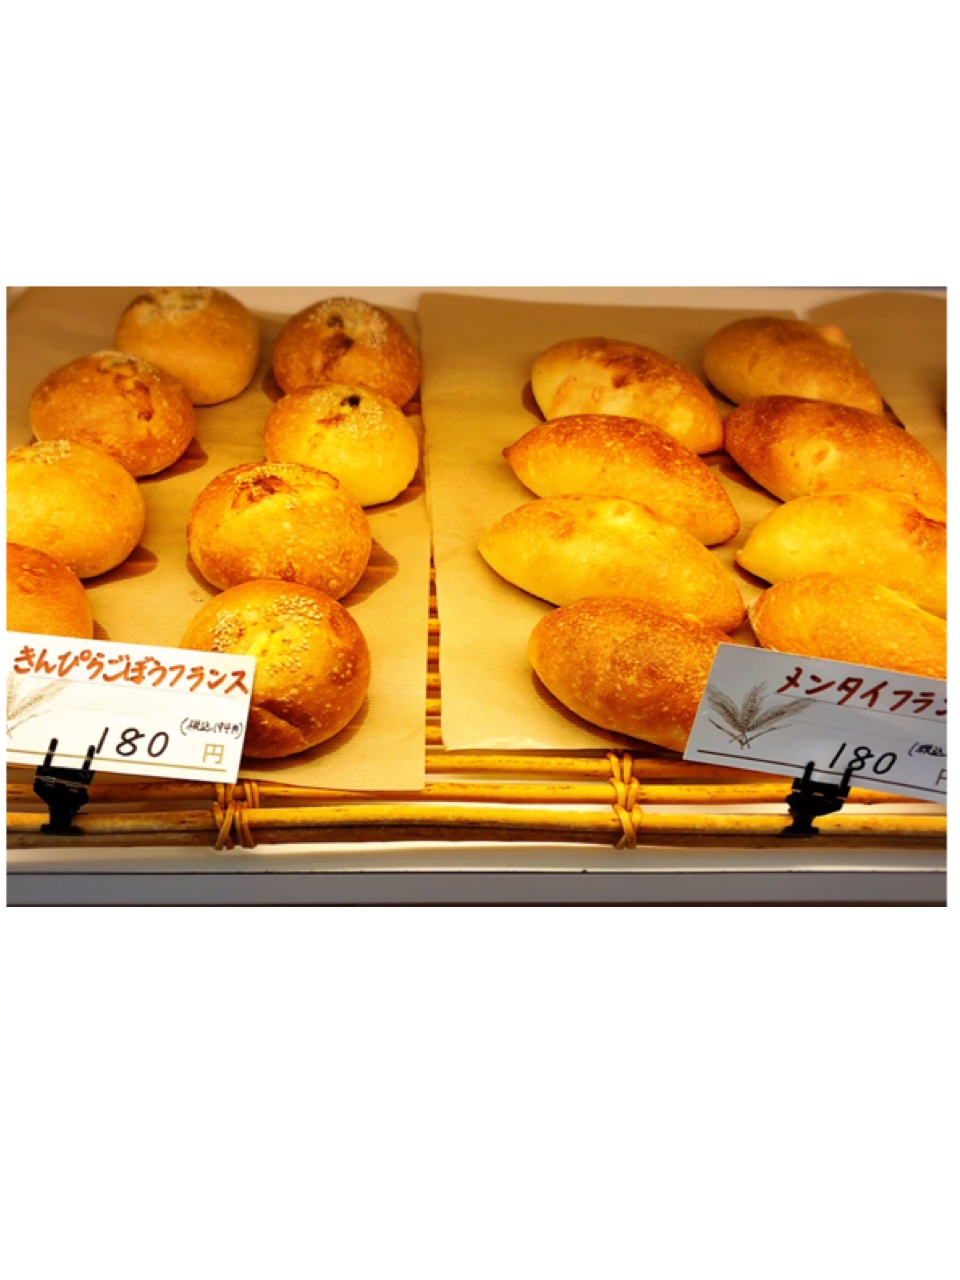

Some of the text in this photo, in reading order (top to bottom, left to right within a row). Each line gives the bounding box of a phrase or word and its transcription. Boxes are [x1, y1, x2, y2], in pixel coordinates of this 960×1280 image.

[14, 645, 249, 695] きんぴらごぼうフランス
[776, 666, 947, 716] メンタイフラ
[96, 726, 225, 764] 180 円
[829, 742, 898, 775] 180
